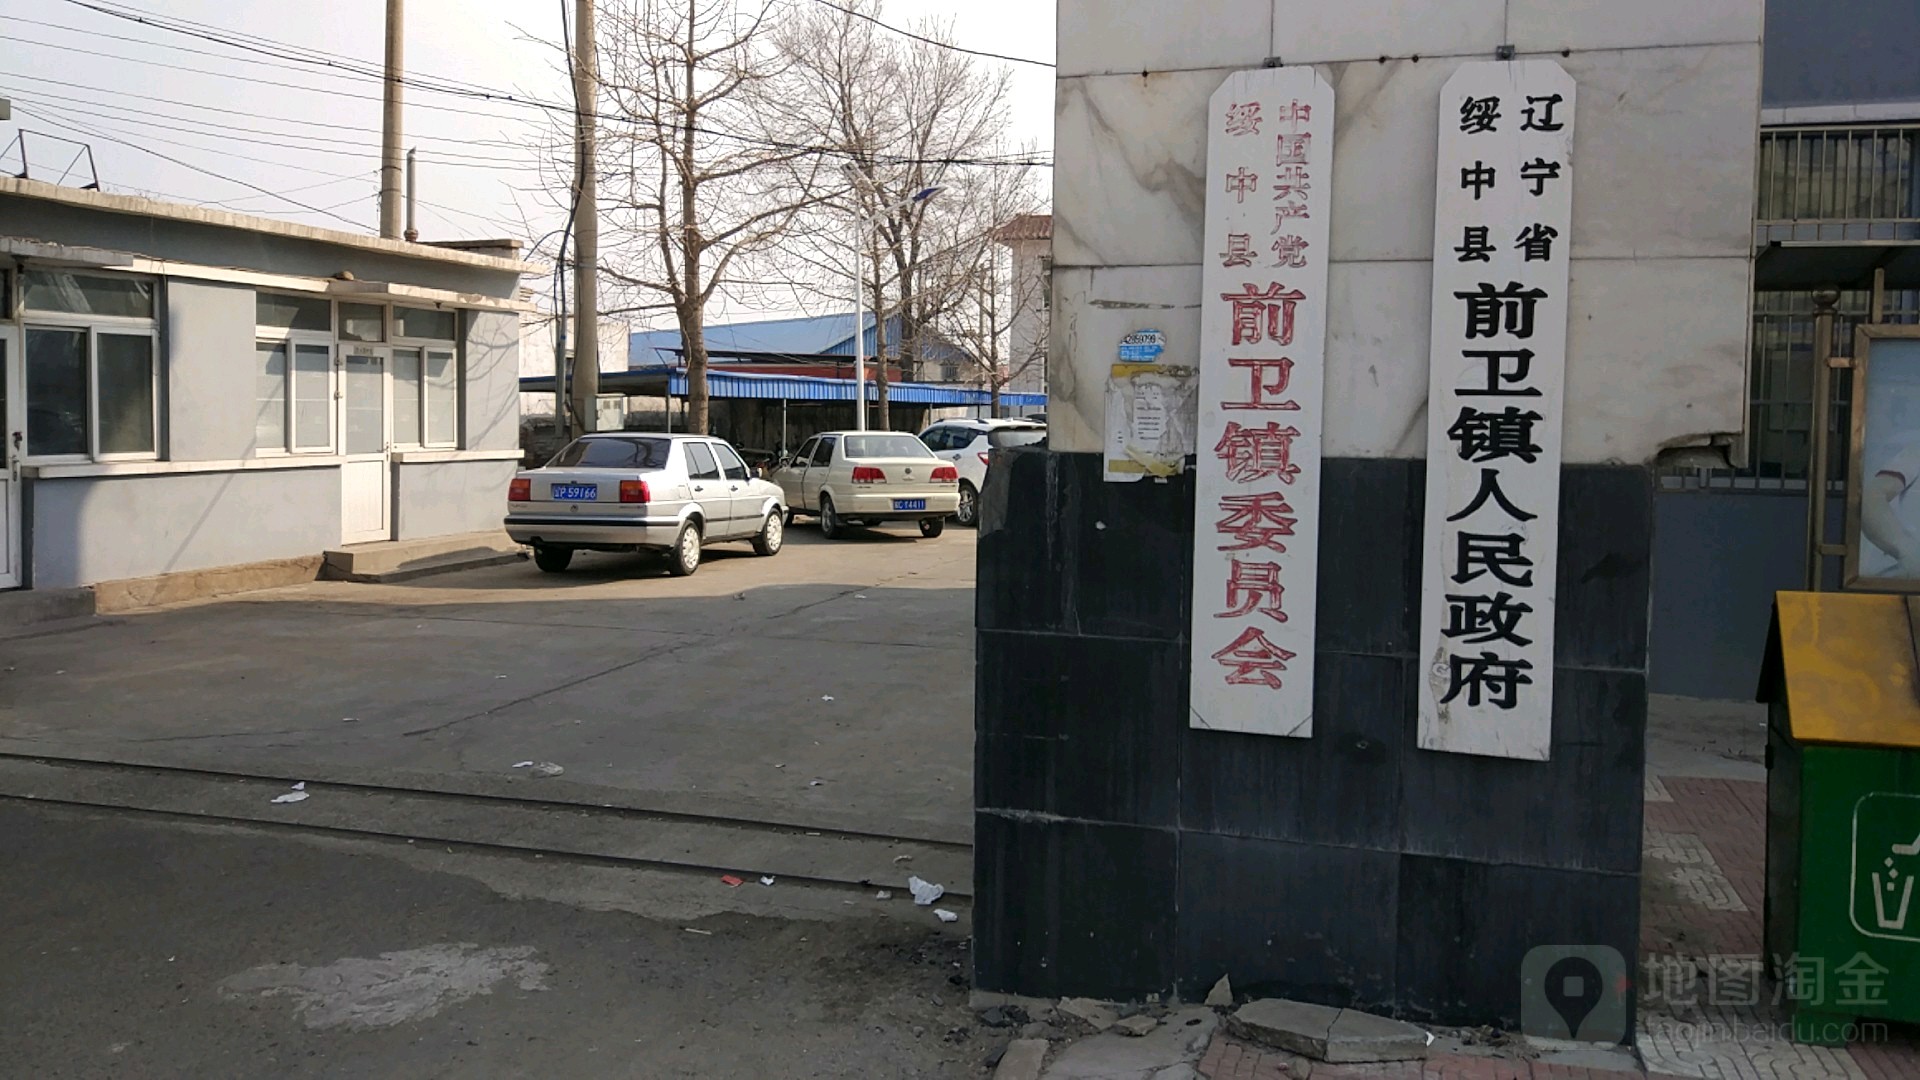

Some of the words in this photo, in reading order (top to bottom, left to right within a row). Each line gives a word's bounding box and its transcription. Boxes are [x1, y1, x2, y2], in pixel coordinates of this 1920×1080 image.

[1220, 101, 1264, 268] 绥中县
[1270, 98, 1312, 269] 中国共产党
[1454, 95, 1502, 263] 绥中县
[1514, 93, 1565, 262] 辽宁省
[1211, 281, 1306, 690] 前卫镇委员会
[1440, 281, 1548, 710] 前卫镇人民政府
